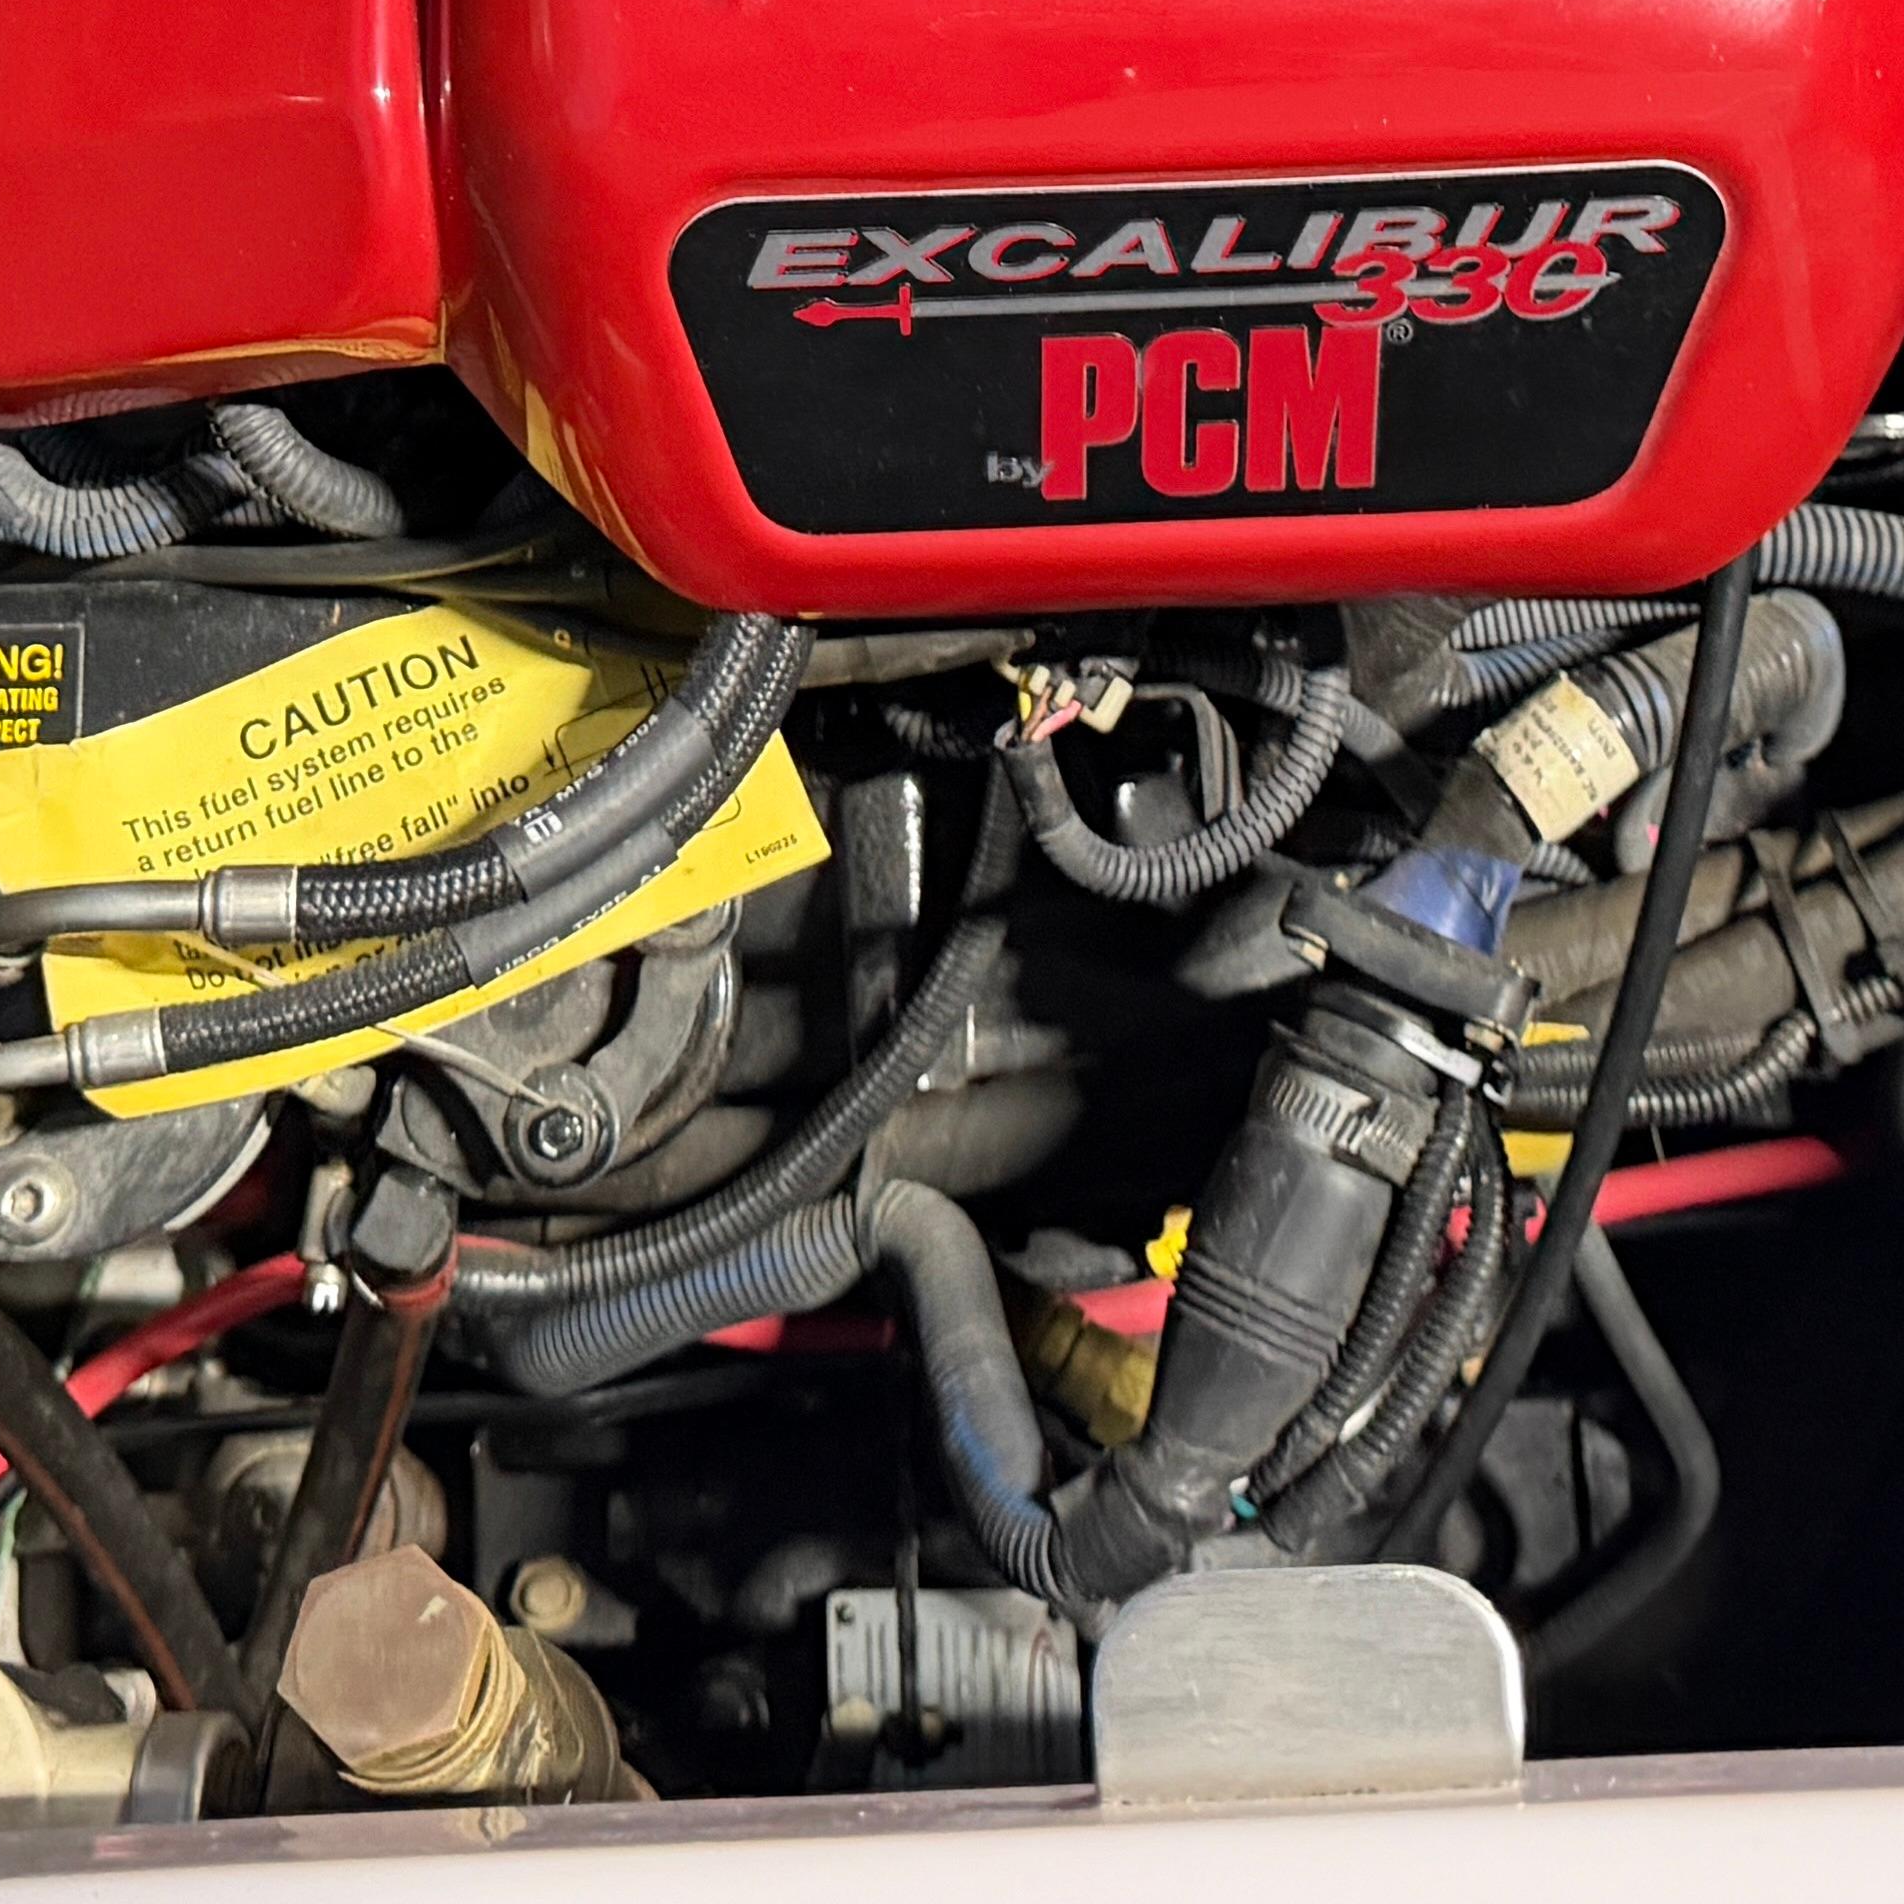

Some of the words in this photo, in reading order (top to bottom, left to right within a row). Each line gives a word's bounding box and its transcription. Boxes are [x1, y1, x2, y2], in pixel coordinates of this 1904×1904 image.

[746, 195, 1682, 289] EXCALIBUR
[1313, 241, 1608, 328] 330
[987, 451, 1054, 488] by
[1041, 327, 1382, 501] PCM
[239, 634, 480, 761] CAUTION
[123, 806, 191, 844] This
[199, 777, 259, 820] fuel
[267, 730, 376, 793] system
[384, 675, 507, 741] requires
[137, 851, 154, 874] a
[164, 820, 258, 870] return
[265, 784, 324, 831] fuel
[330, 760, 386, 801] line
[394, 744, 424, 775] to
[430, 719, 480, 756] the
[469, 772, 530, 813] into
[186, 967, 225, 990] Do
